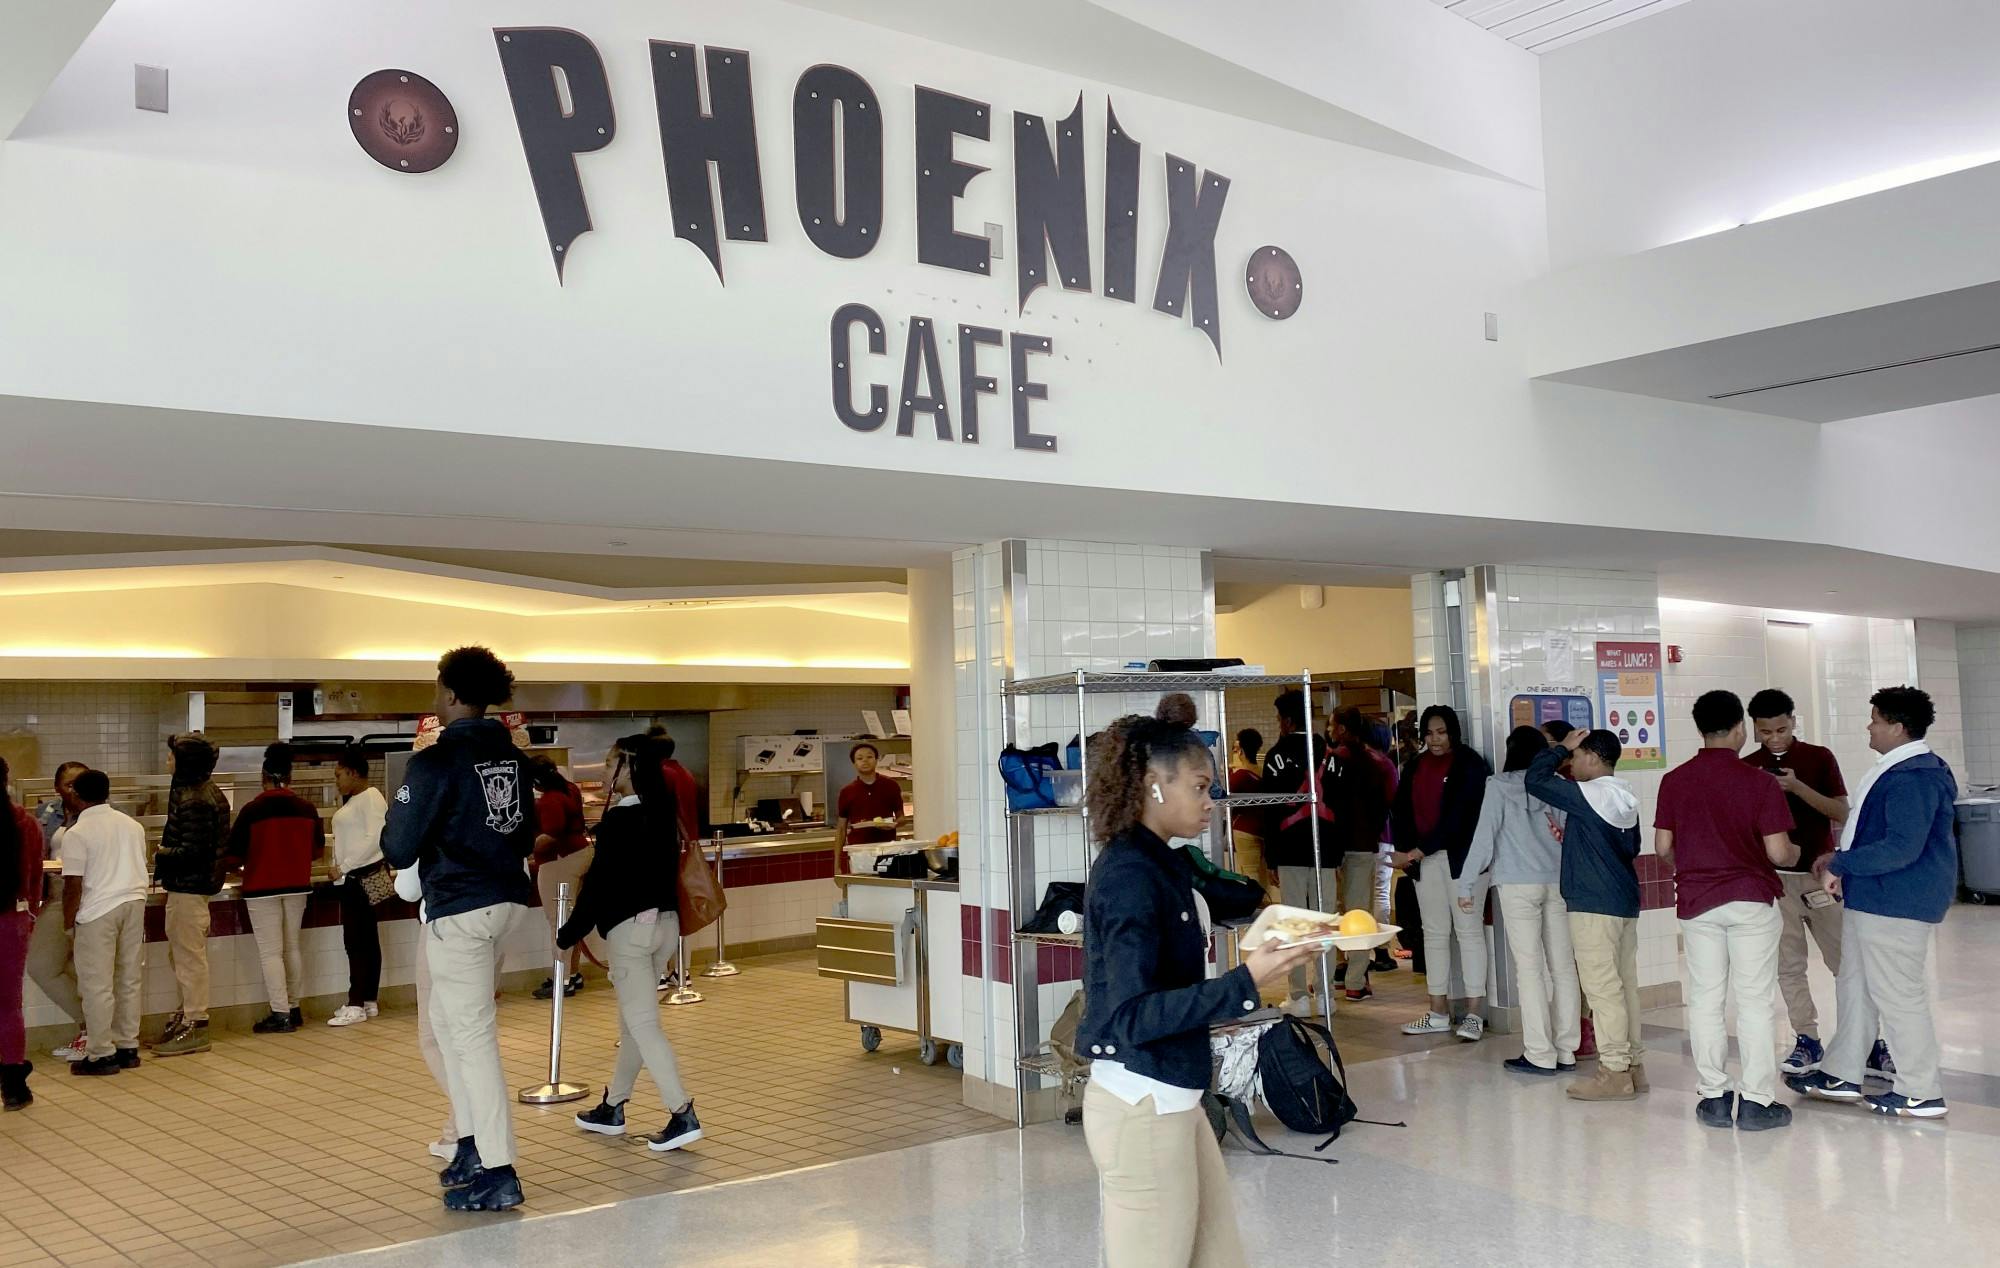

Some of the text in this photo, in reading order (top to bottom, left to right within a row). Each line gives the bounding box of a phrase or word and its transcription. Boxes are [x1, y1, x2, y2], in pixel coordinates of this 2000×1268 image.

[493, 27, 1231, 366] PHOENIX
[831, 303, 1058, 453] CAFE
[1624, 652, 1648, 668] LUNCH
